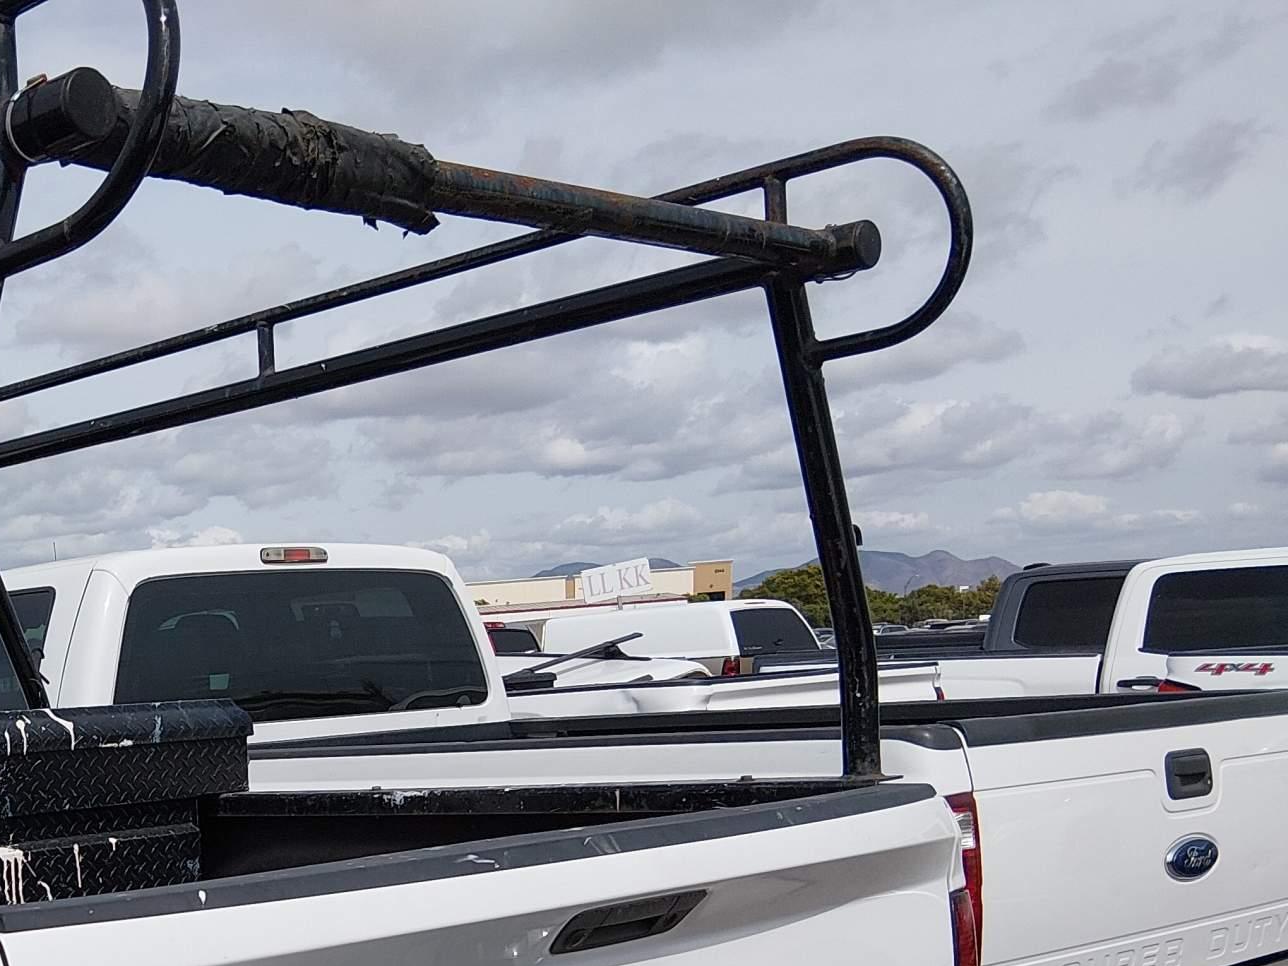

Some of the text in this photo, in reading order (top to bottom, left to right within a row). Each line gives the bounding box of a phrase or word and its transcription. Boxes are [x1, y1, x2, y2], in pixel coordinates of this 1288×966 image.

[587, 563, 650, 596] LL KK
[1206, 911, 1288, 960] DUTY
